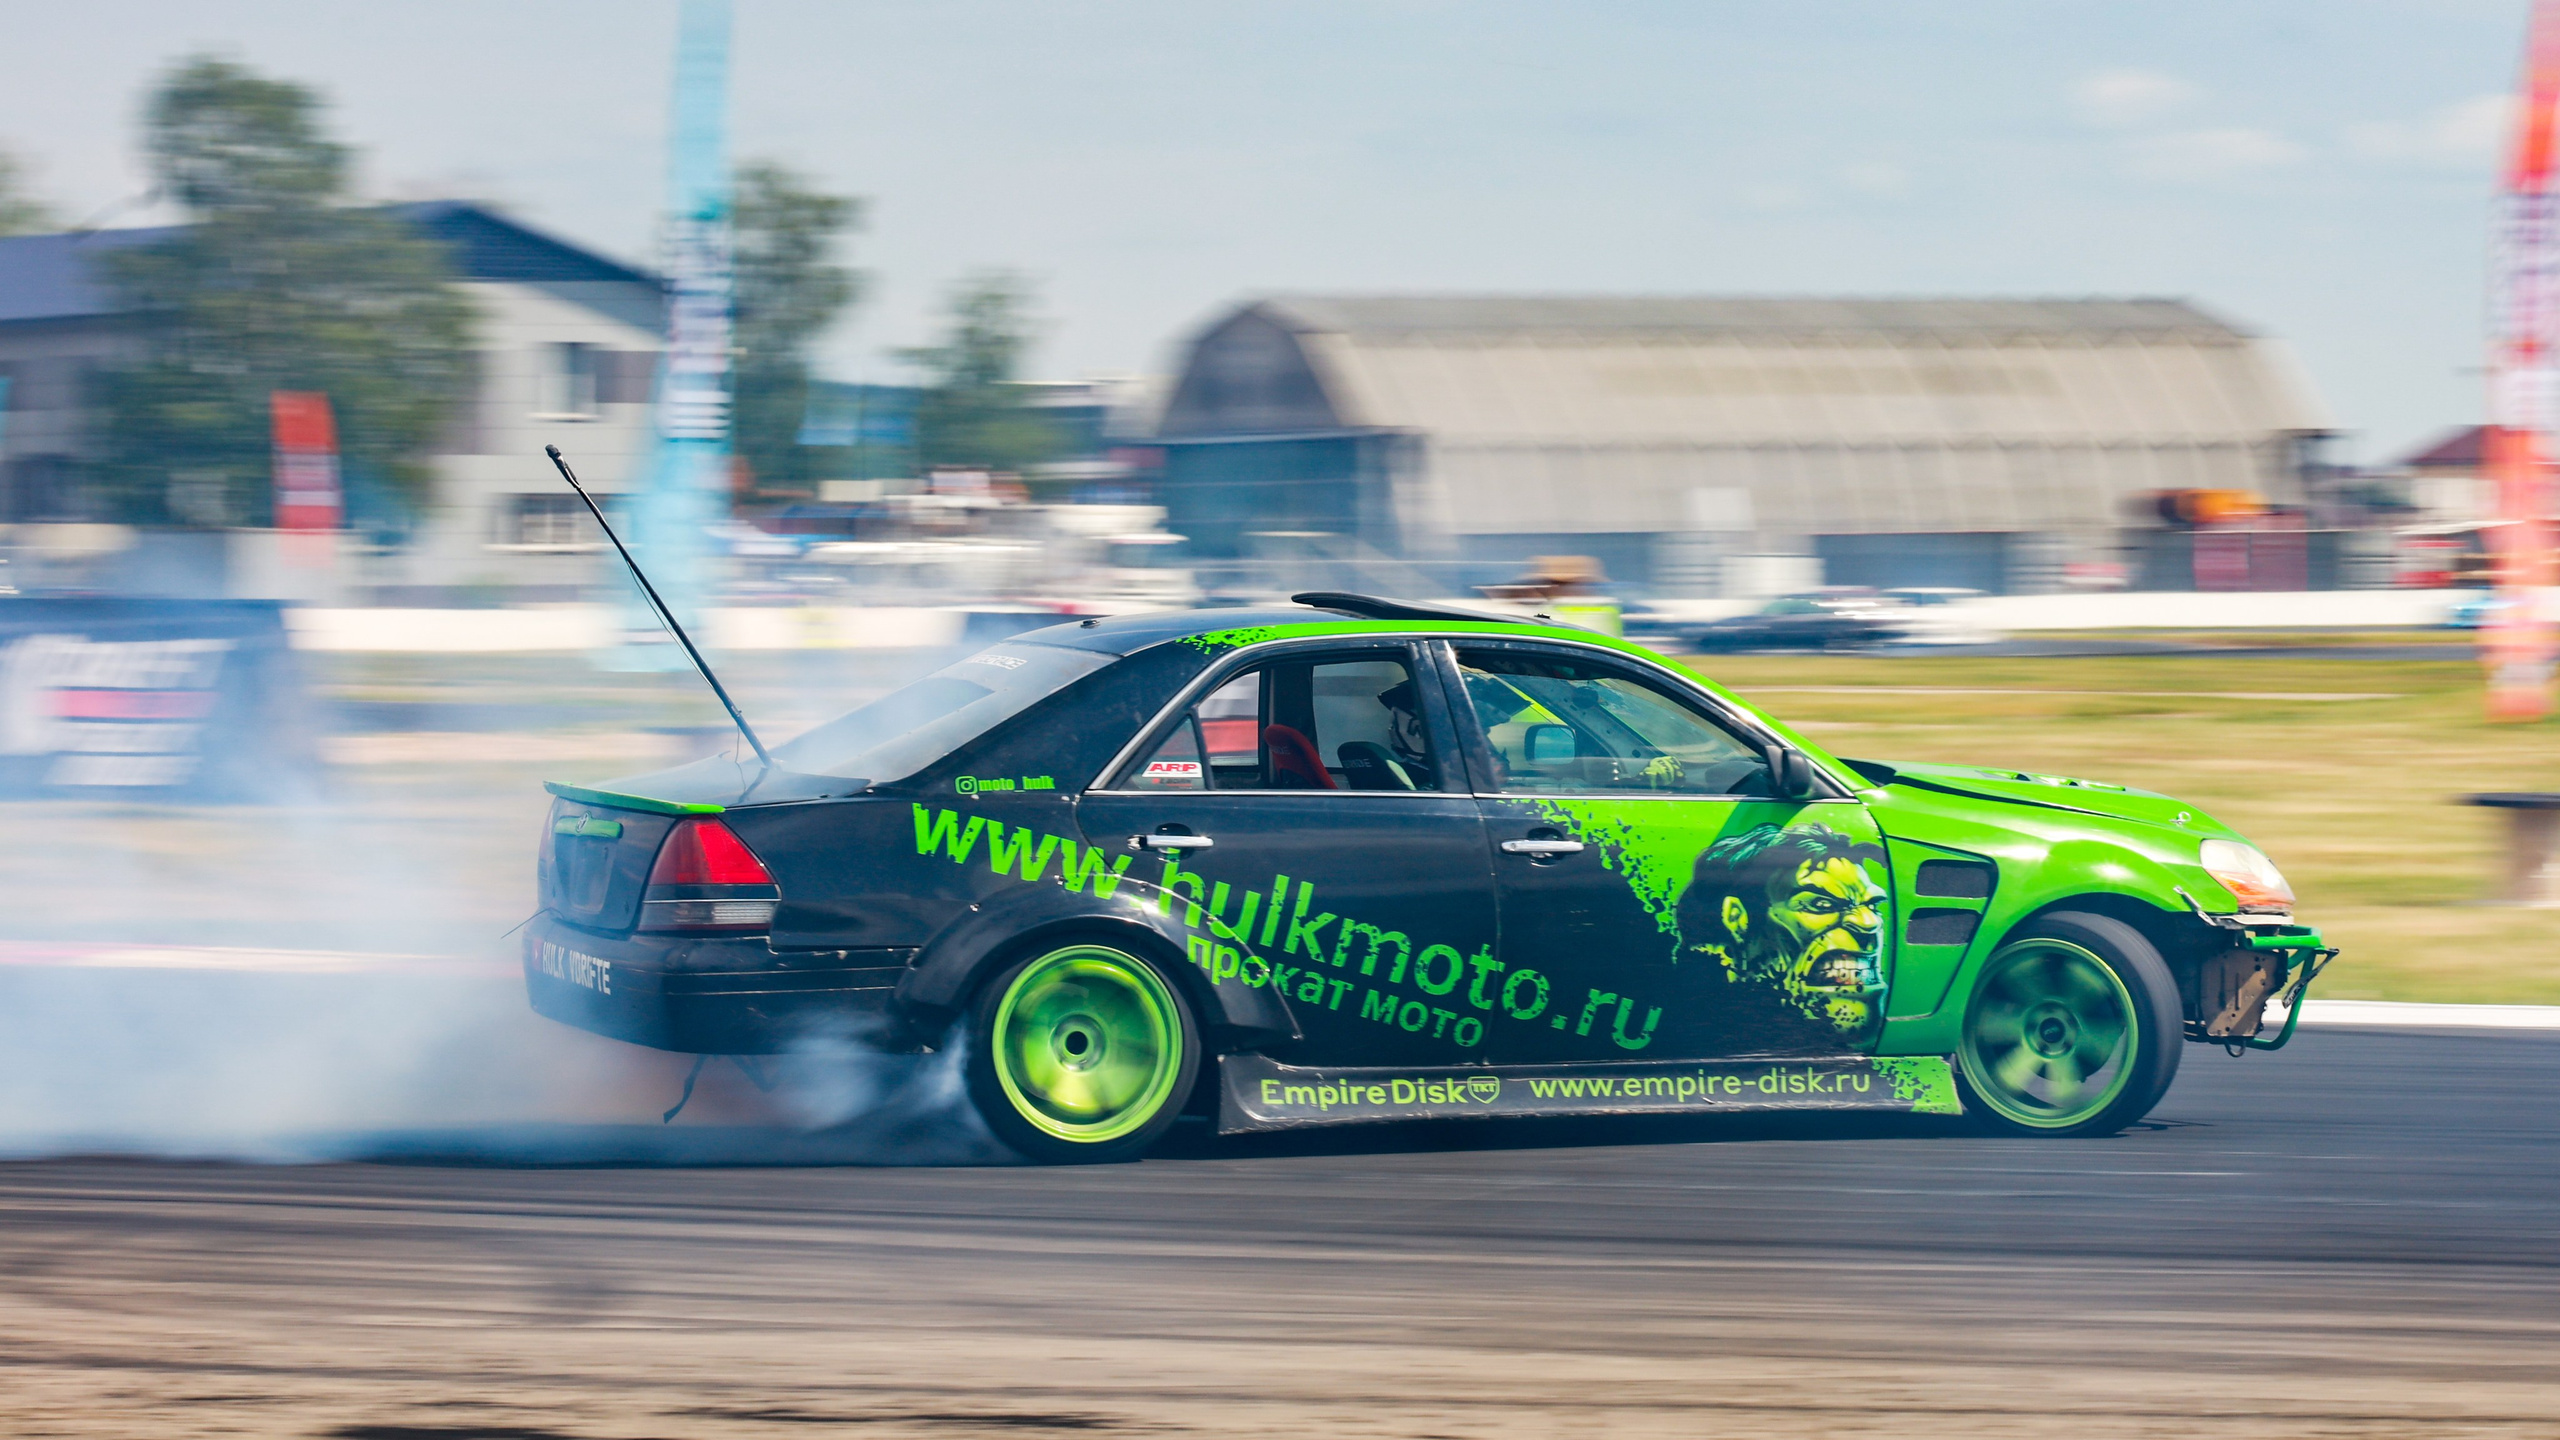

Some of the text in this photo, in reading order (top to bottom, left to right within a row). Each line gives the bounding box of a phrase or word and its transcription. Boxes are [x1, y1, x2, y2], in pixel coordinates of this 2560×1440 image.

[978, 776, 1055, 792] moto_hulk
[1149, 763, 1197, 772] ARP
[912, 802, 1663, 1050] www.hulkmoto.ru
[542, 941, 565, 980] HULK
[1187, 934, 1485, 1048] прокат мото
[1260, 1078, 1469, 1111] Empire Disk
[1529, 1066, 1871, 1102] www.empire-disk.ru
